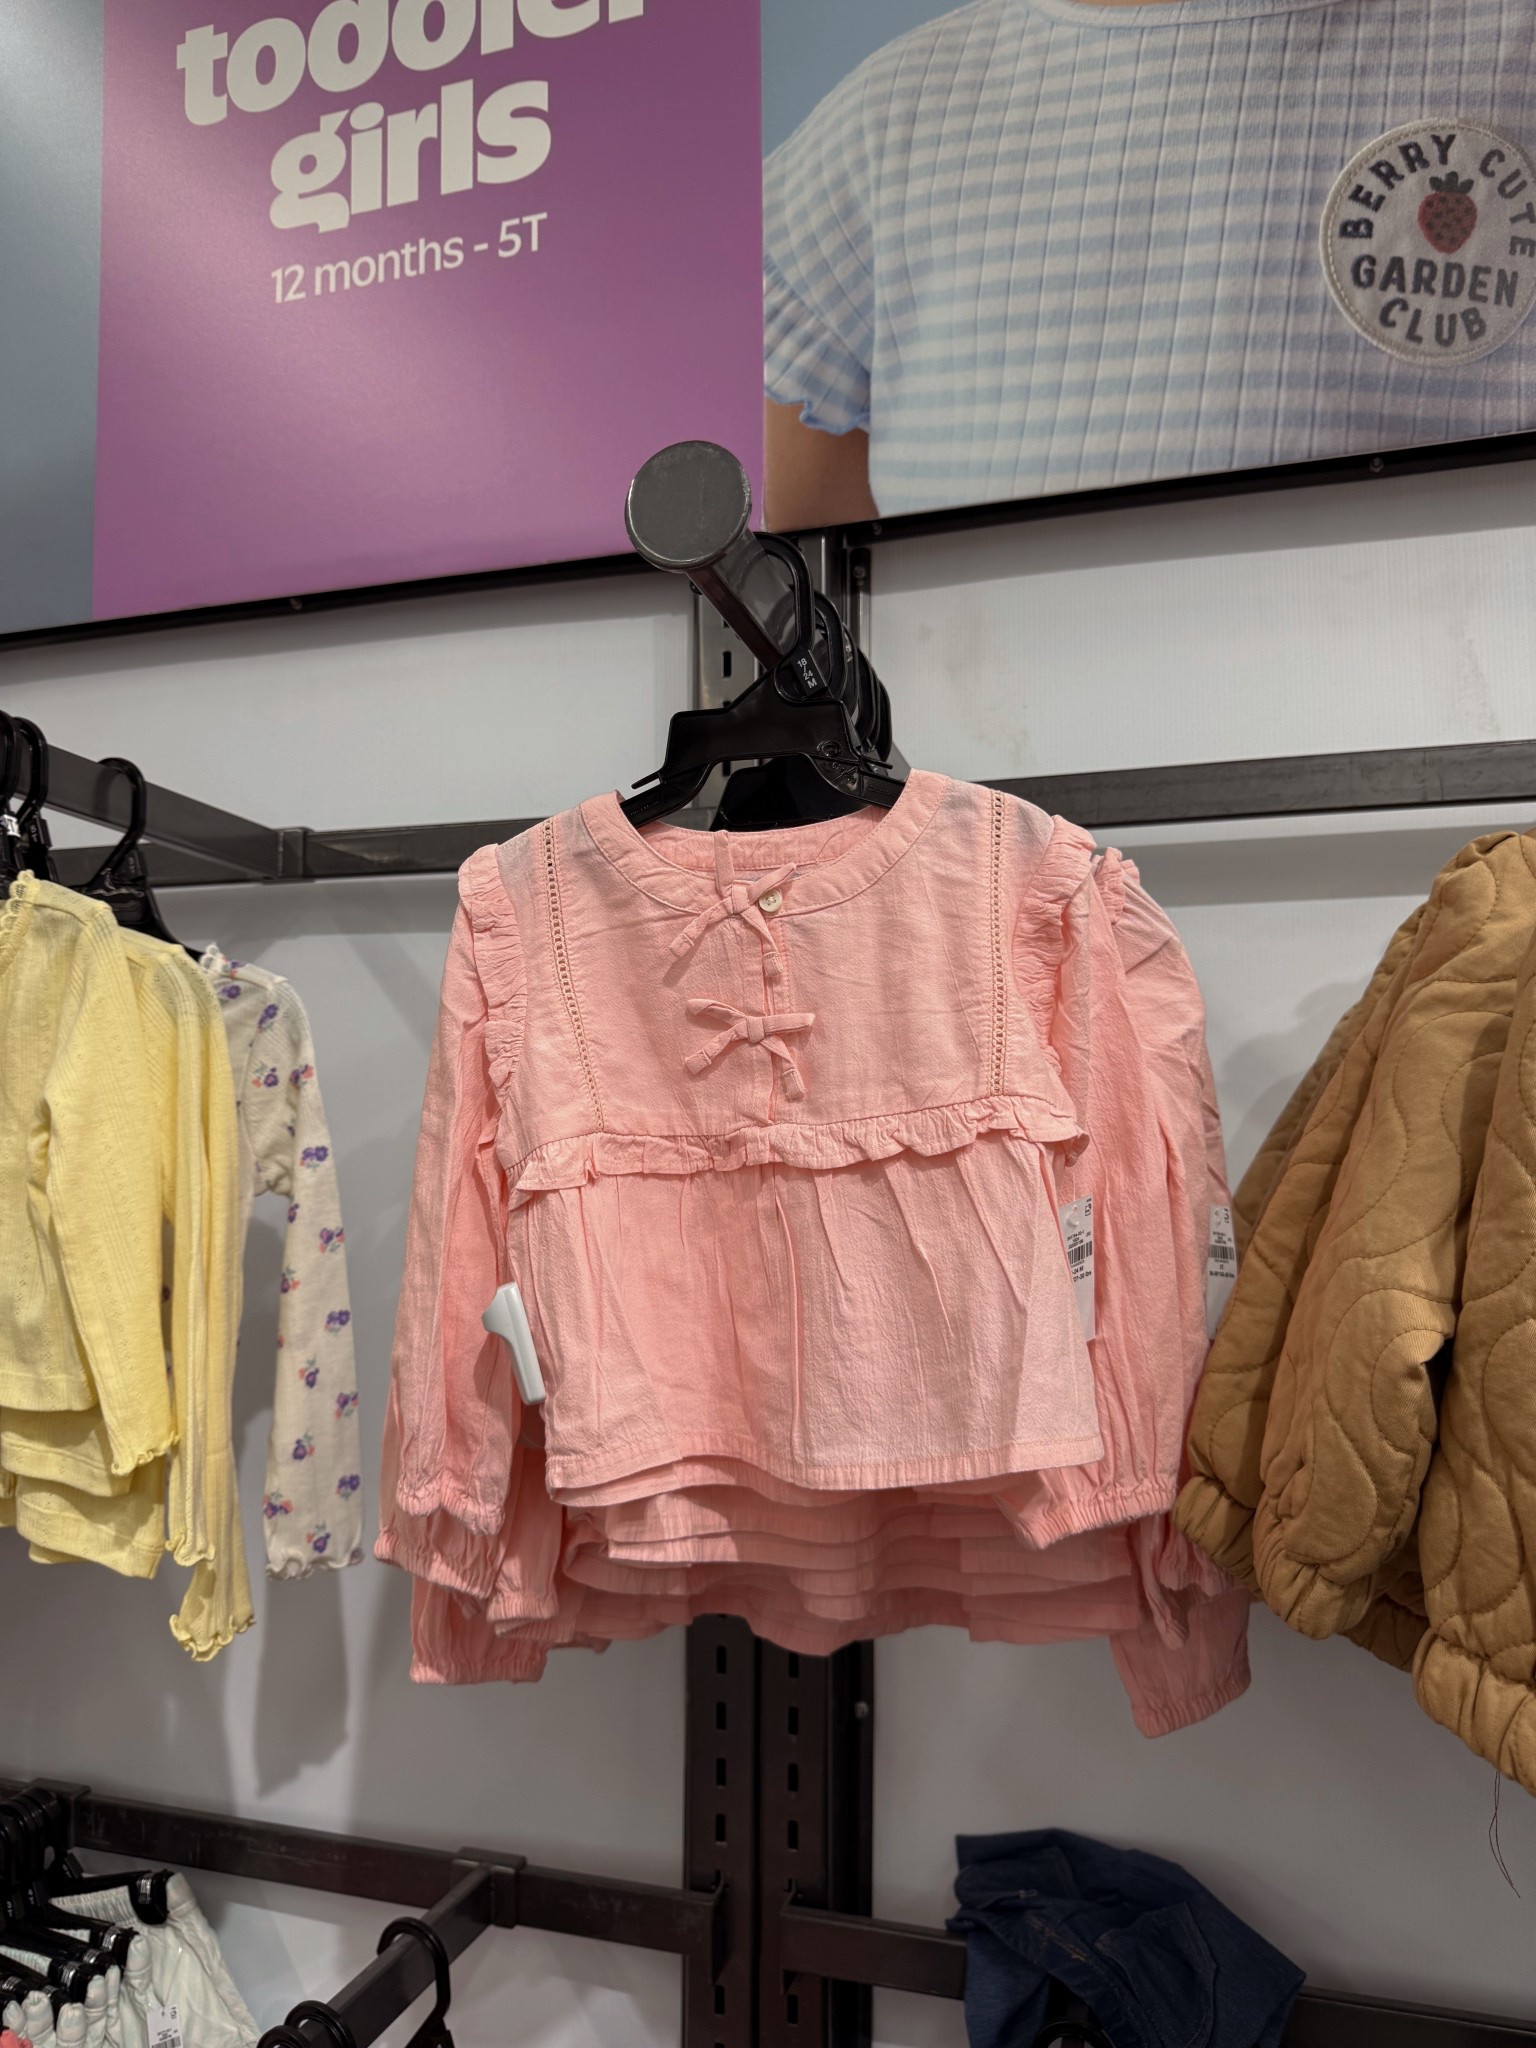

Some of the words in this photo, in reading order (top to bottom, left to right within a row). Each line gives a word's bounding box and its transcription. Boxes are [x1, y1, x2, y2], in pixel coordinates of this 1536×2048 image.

[177, 0, 644, 125] todd
[269, 78, 552, 233] girls
[1339, 133, 1457, 239] BERRY
[1479, 149, 1536, 258] CUTE
[271, 264, 306, 303] 12
[314, 236, 465, 296] months
[498, 212, 548, 258] 5T
[1352, 254, 1519, 308] GARDEN
[1379, 298, 1487, 347] CLUB
